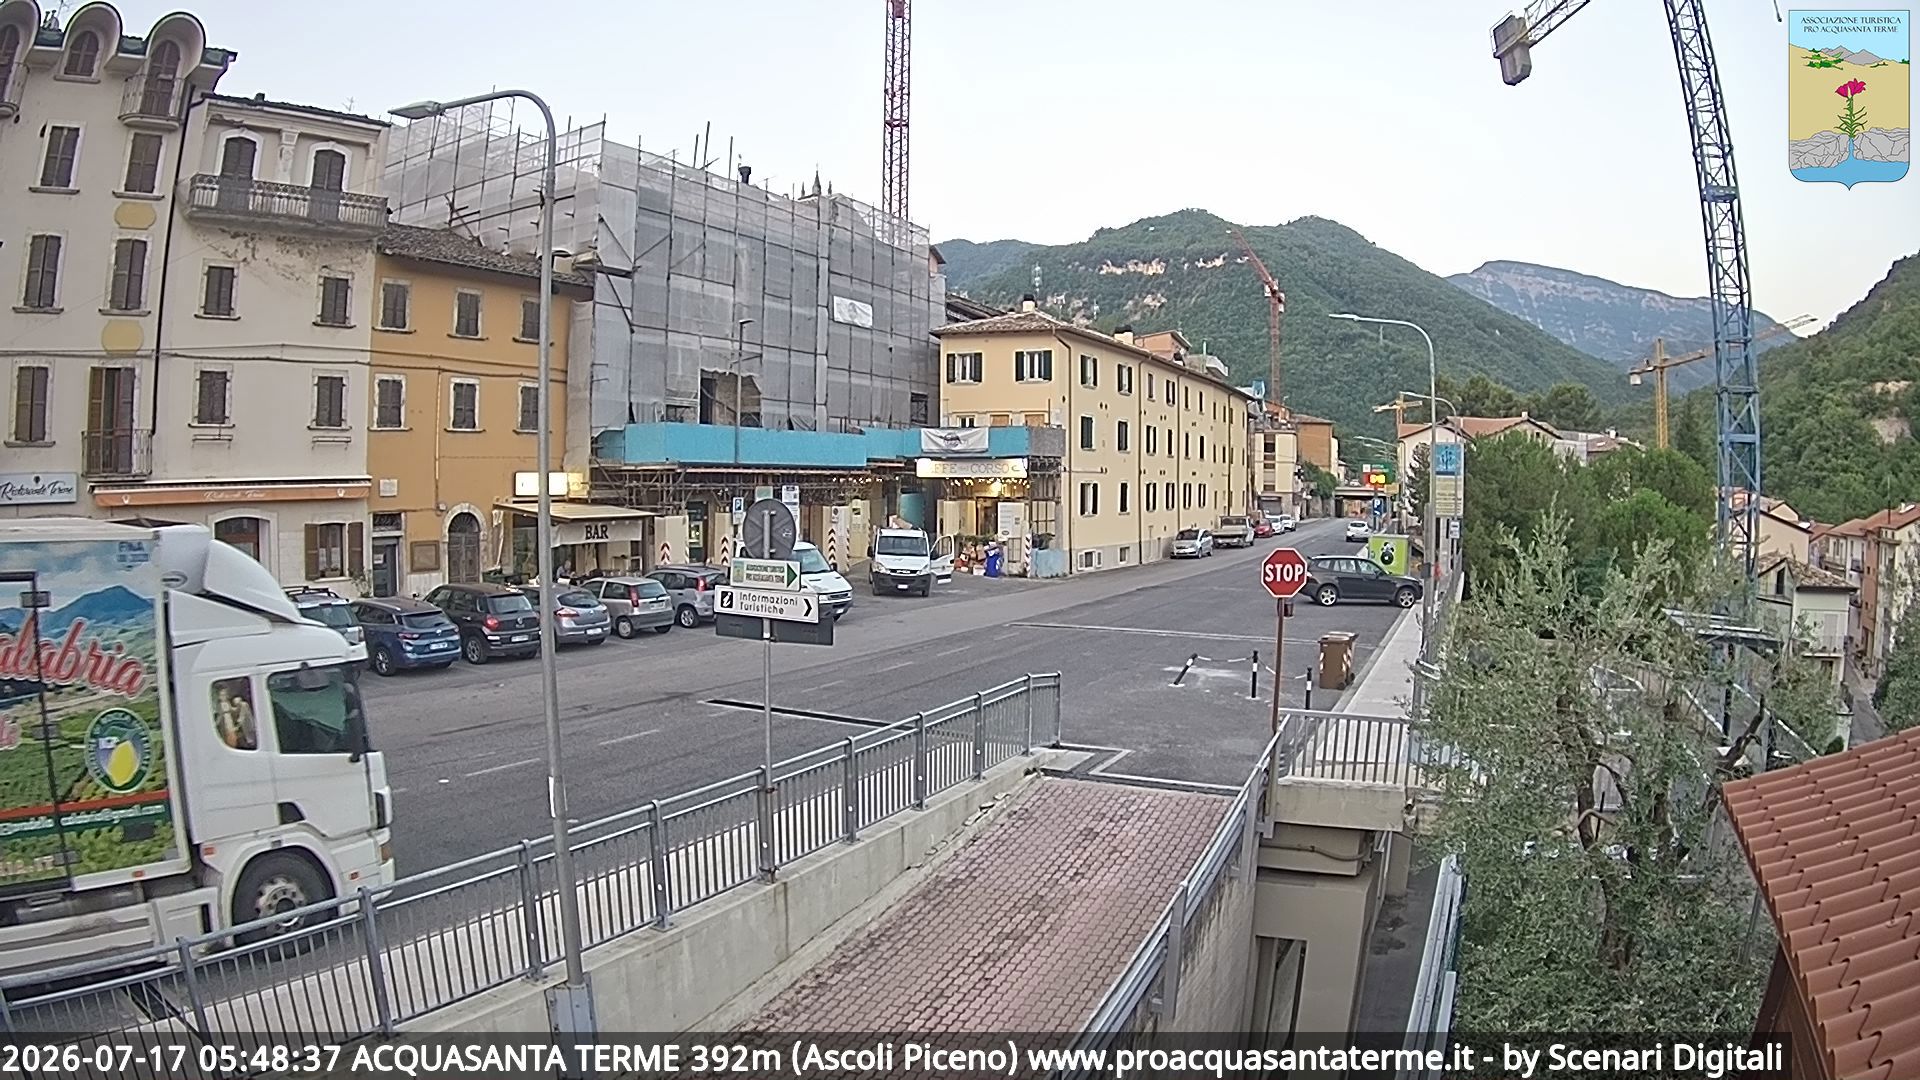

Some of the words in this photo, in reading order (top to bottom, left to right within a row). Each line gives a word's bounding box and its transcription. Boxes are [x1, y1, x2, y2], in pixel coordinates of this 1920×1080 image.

[970, 463, 1009, 474] CORSO
[585, 524, 609, 540] BAR
[1265, 563, 1304, 582] STOP
[740, 592, 798, 606] Informazioni
[740, 601, 785, 615] Turistiche
